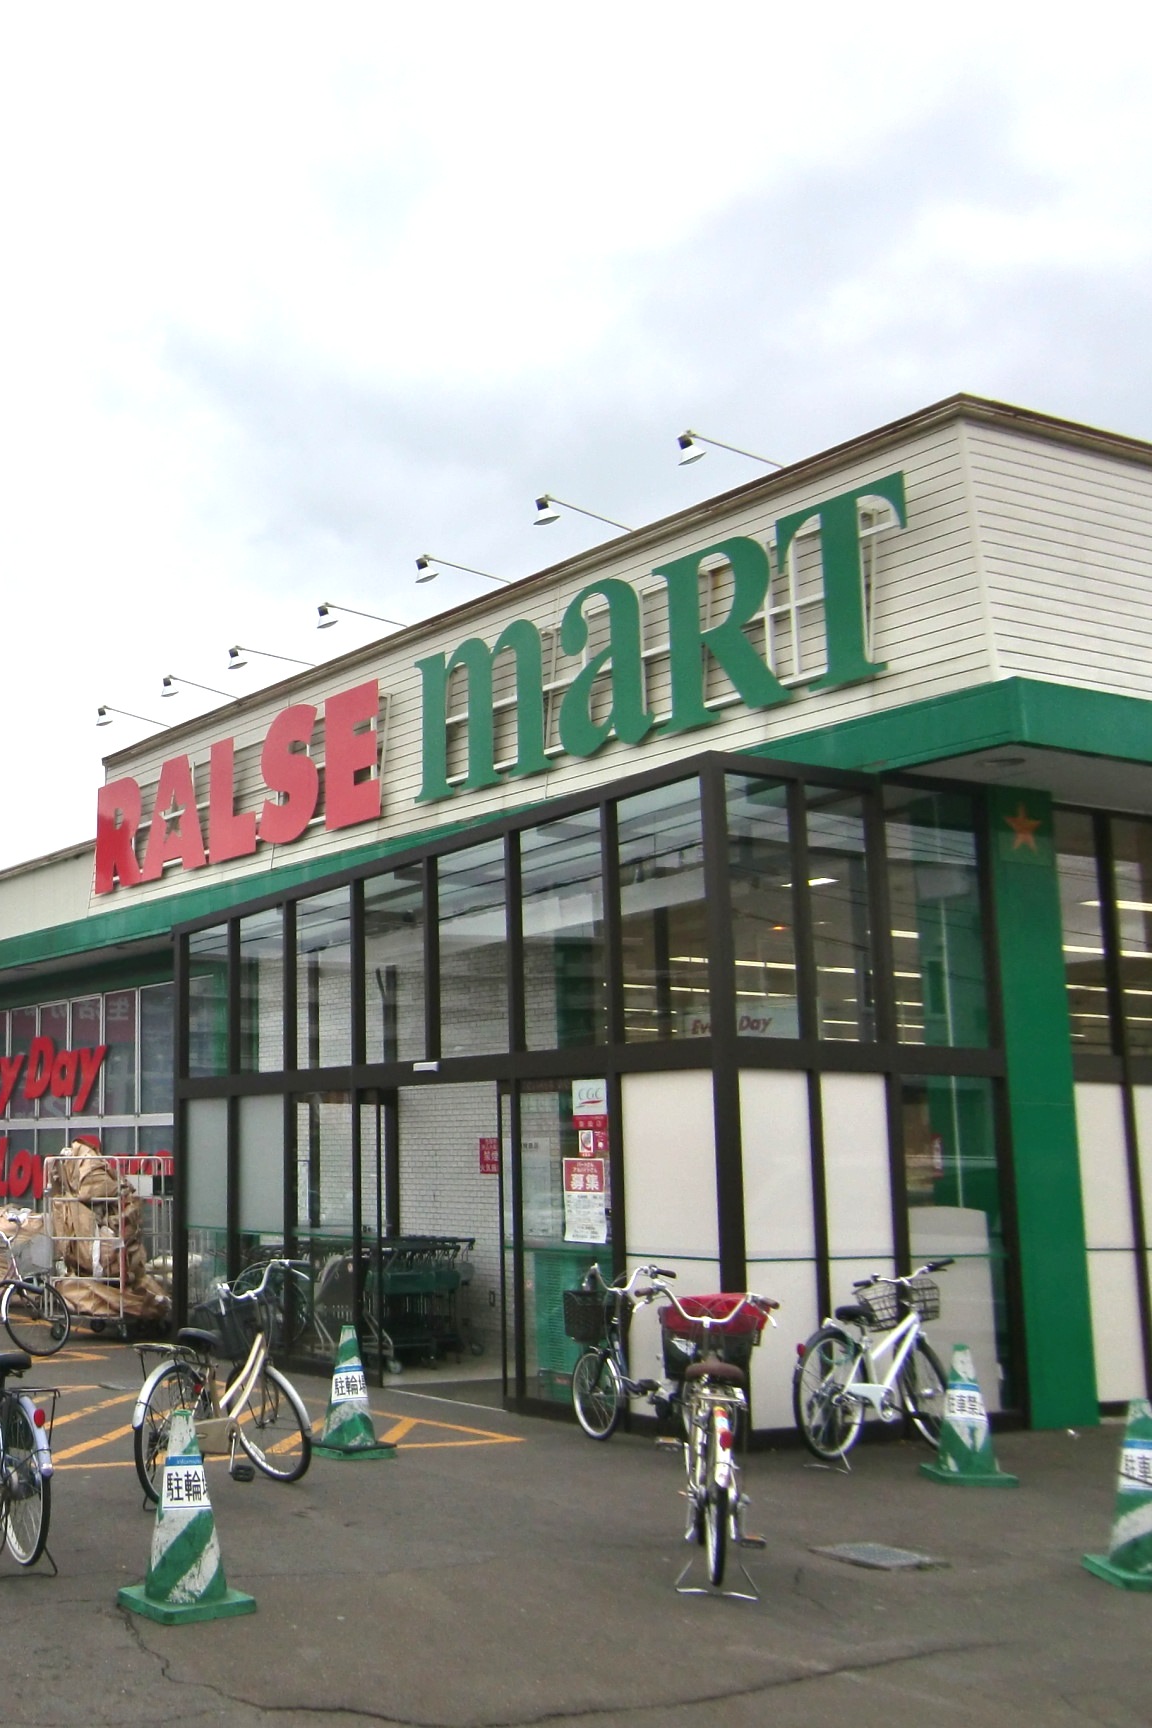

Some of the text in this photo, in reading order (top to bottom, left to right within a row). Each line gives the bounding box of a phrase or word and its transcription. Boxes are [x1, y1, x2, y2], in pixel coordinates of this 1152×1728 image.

[94, 678, 381, 894] RALSE
[738, 1015, 772, 1034] Day
[24, 1036, 108, 1112] Day
[578, 1087, 603, 1100] CGC
[570, 1173, 600, 1190] 募集
